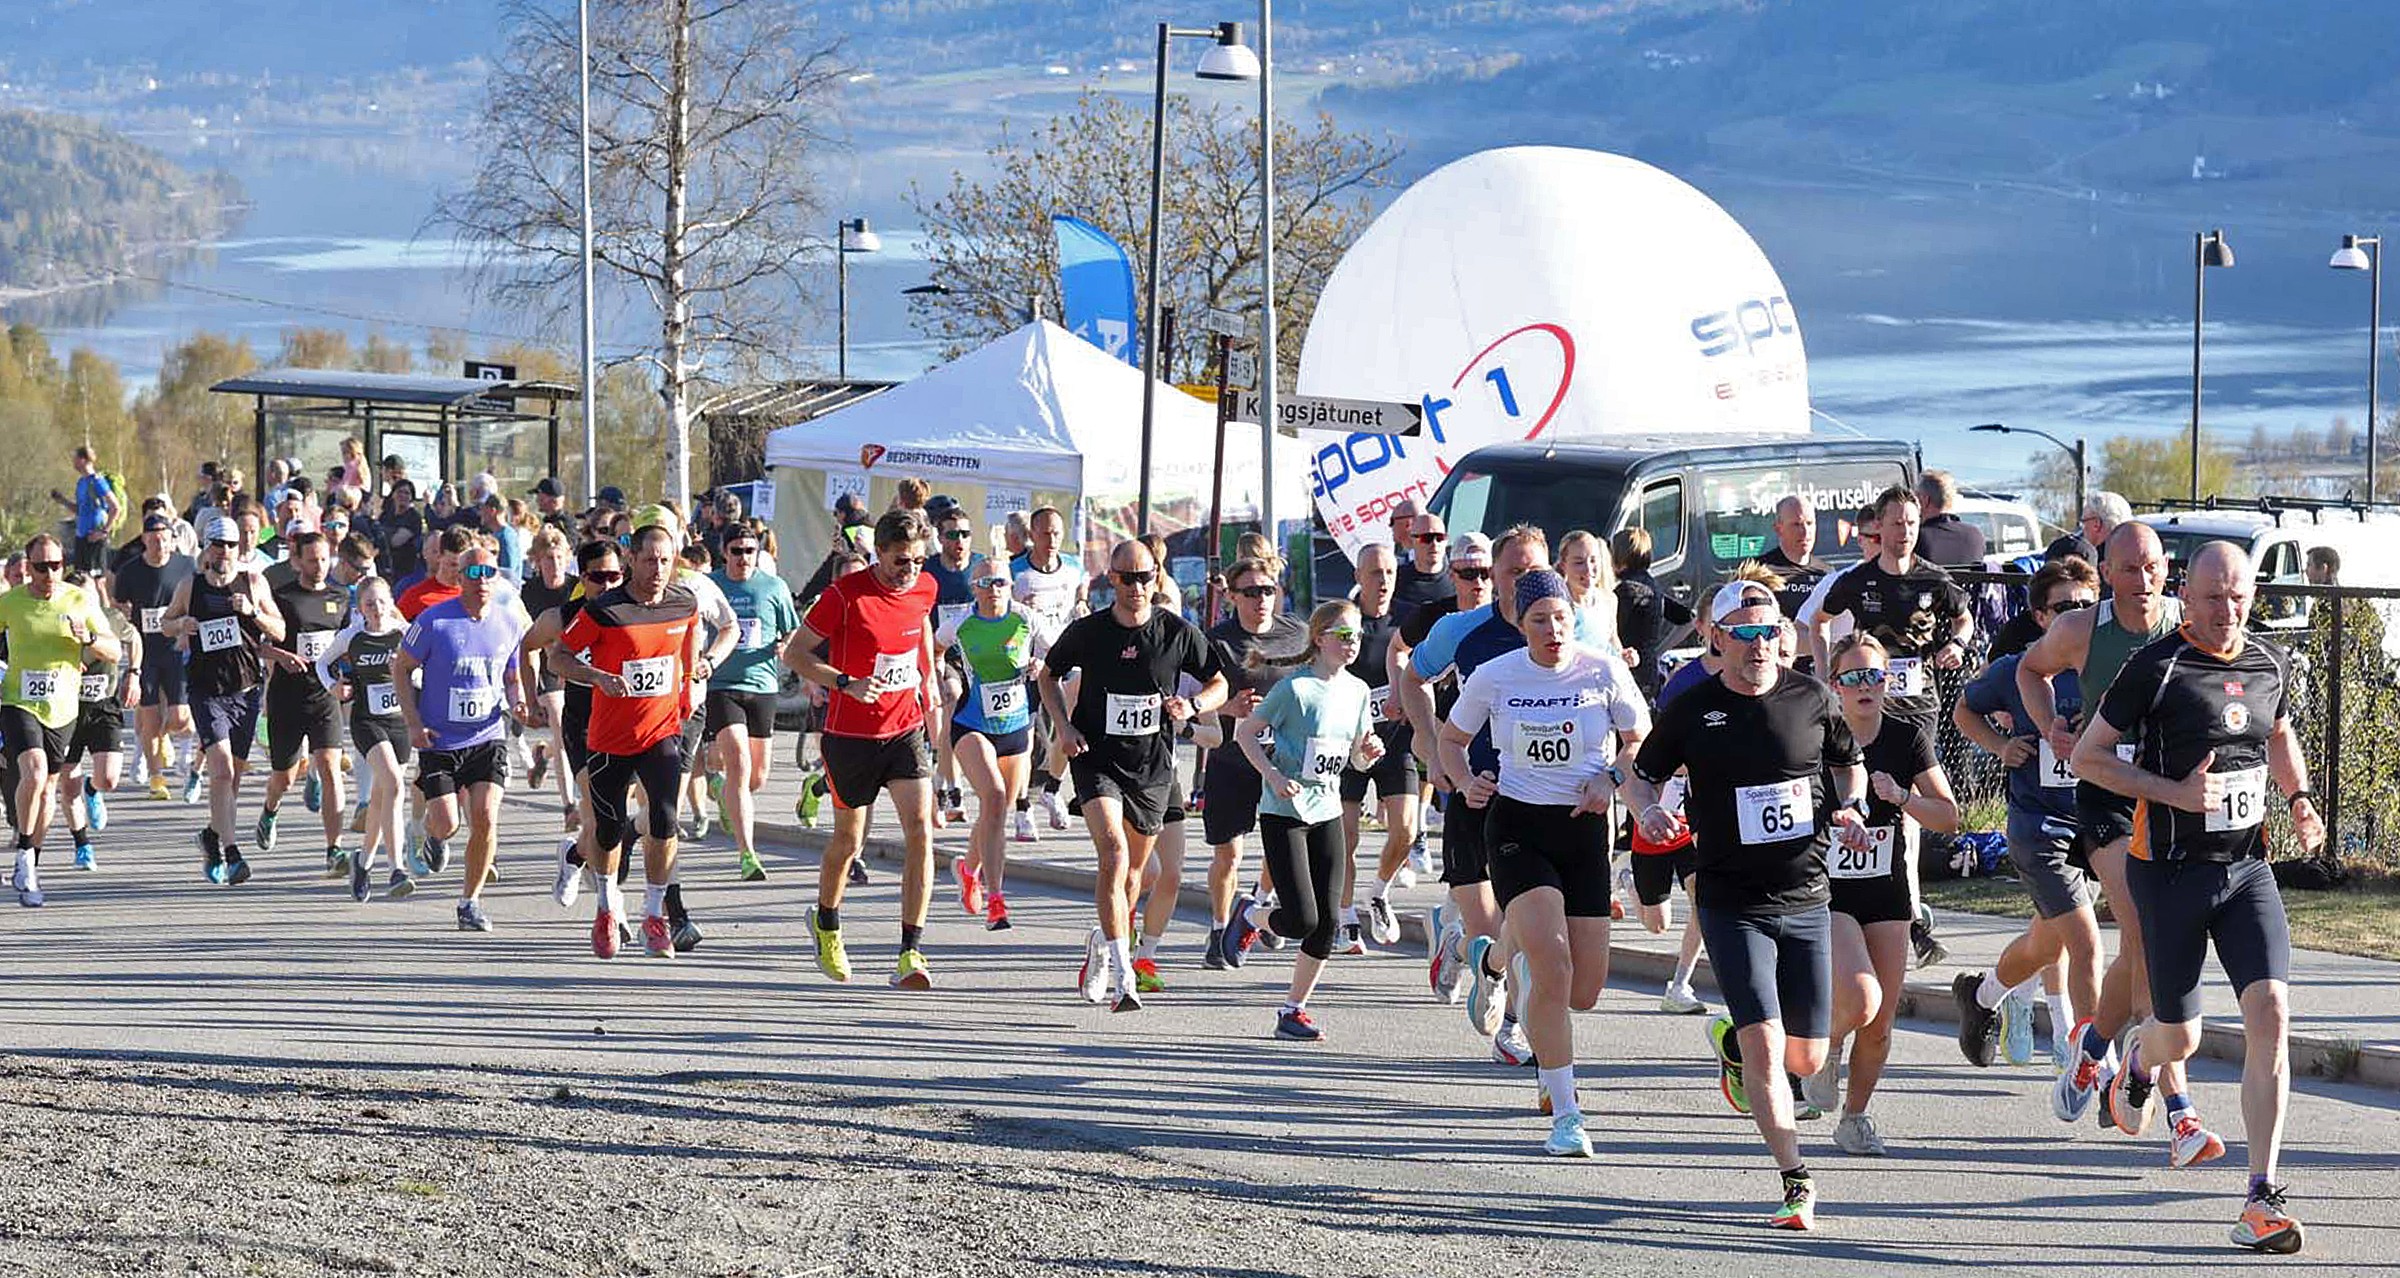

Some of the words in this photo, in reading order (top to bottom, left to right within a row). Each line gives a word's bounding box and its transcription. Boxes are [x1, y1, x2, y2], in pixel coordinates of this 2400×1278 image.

[1486, 366, 1520, 417] 1
[1245, 396, 1383, 426] Kngsjåtunet
[886, 451, 981, 470] BEDRIFTSIDRETTEN
[208, 628, 233, 646] 204
[29, 680, 56, 696] 294
[632, 671, 664, 692] 324
[458, 700, 484, 718] 101
[1508, 697, 1571, 708] CRAFT
[1116, 709, 1152, 729] 418
[1526, 738, 1571, 762] 460
[1314, 754, 1342, 776] 346
[2221, 790, 2257, 822] 181
[1762, 804, 1795, 834] 65
[1837, 845, 1878, 871] 201
